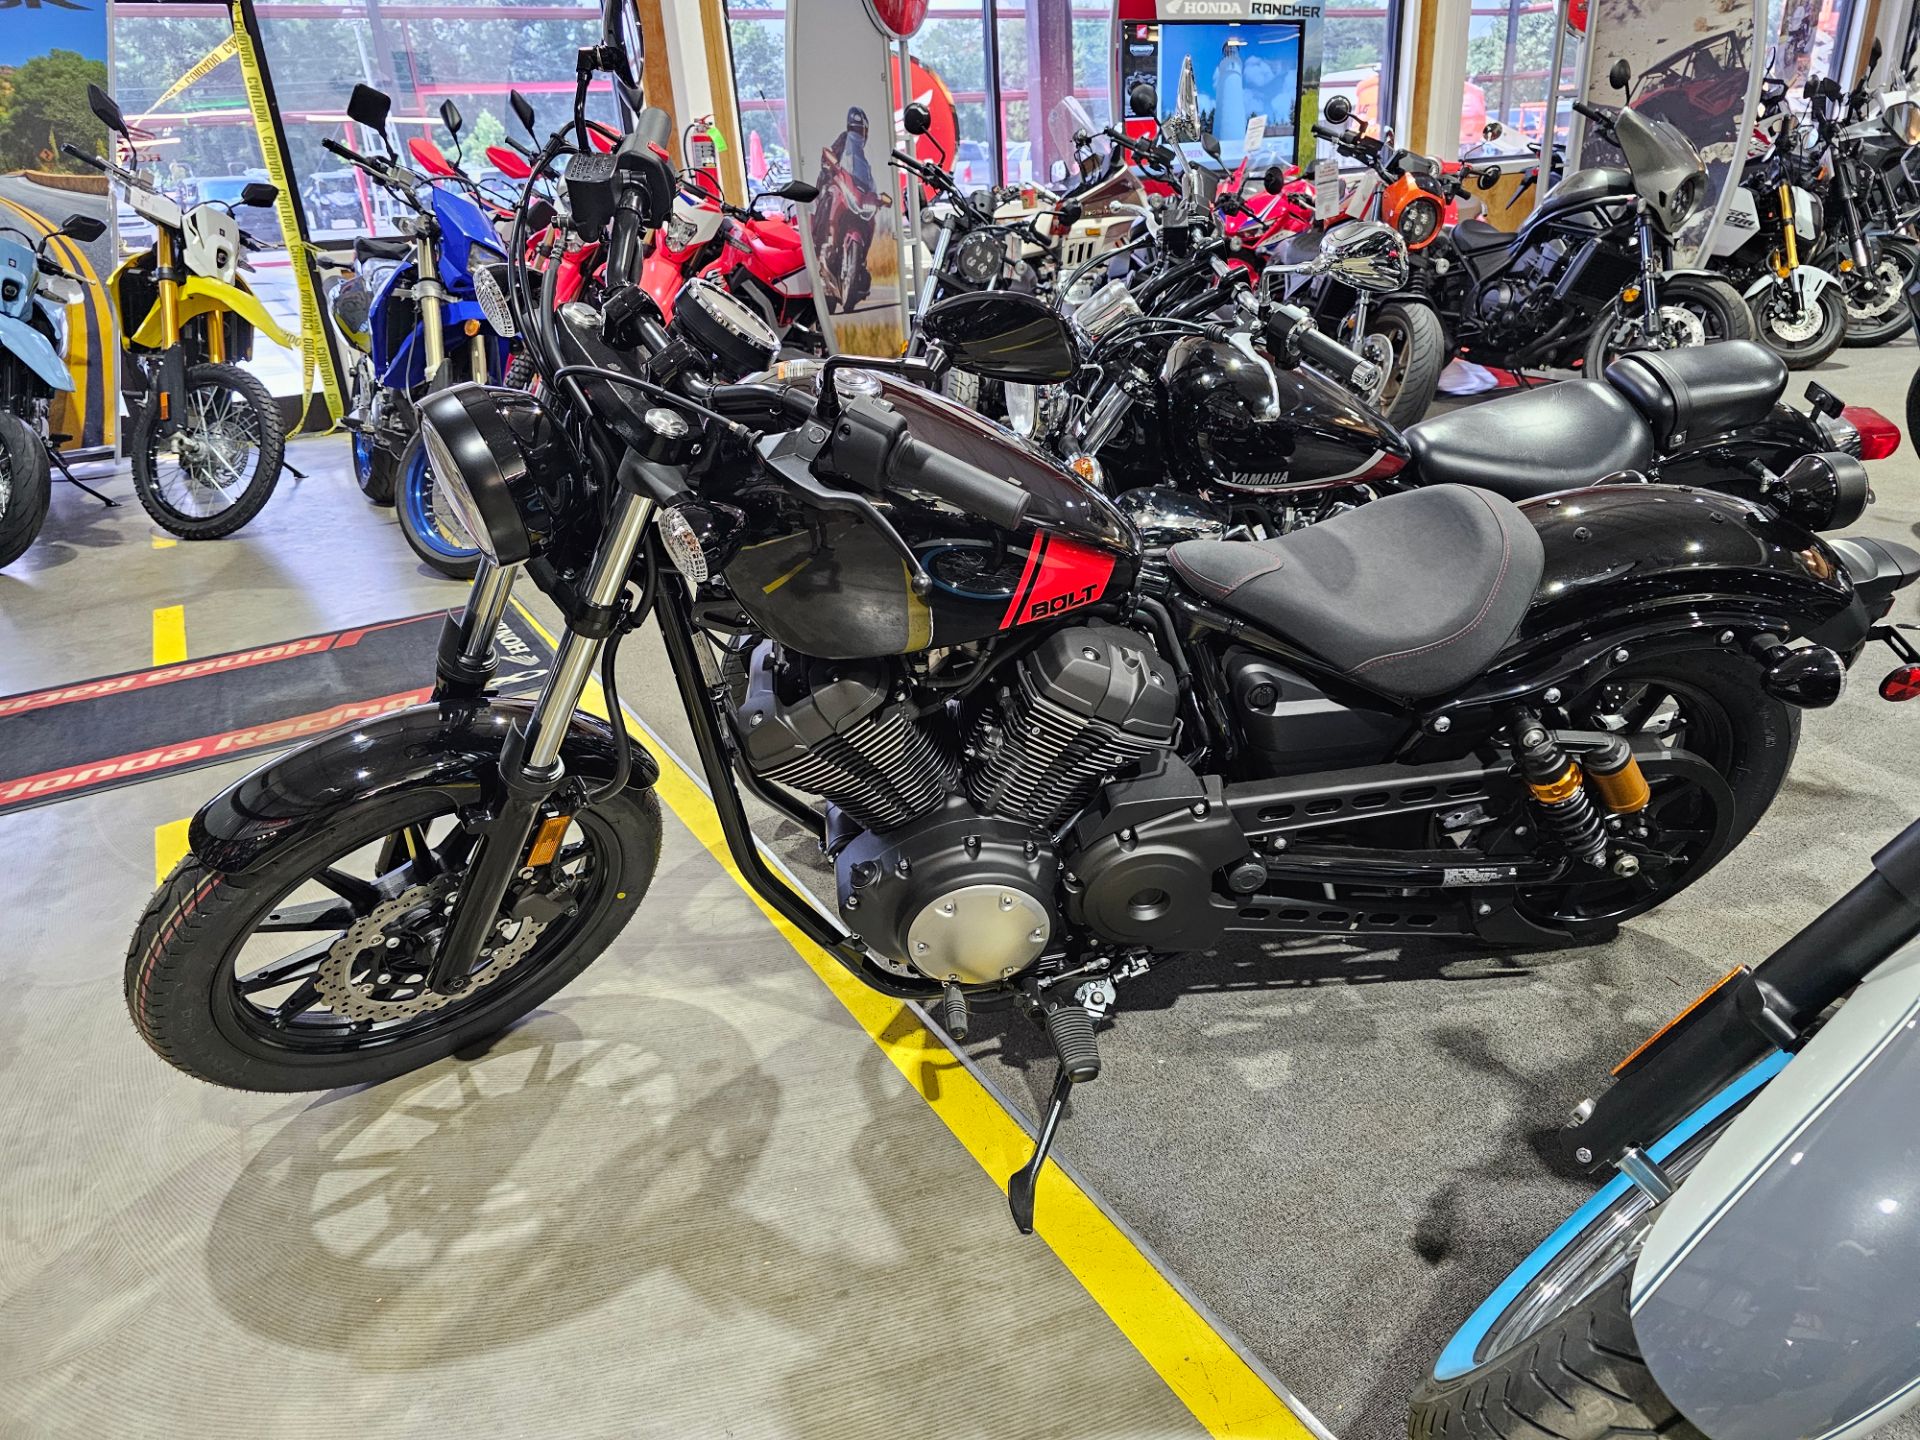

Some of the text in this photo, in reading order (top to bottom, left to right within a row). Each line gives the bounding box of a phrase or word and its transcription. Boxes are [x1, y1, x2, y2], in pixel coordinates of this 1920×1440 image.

[1184, 1, 1321, 18] HONDA RANCHER
[1231, 471, 1289, 484] YAMAHA
[1031, 584, 1098, 619] BOLT
[496, 619, 531, 655] HOND
[0, 640, 322, 711] Honda Raci
